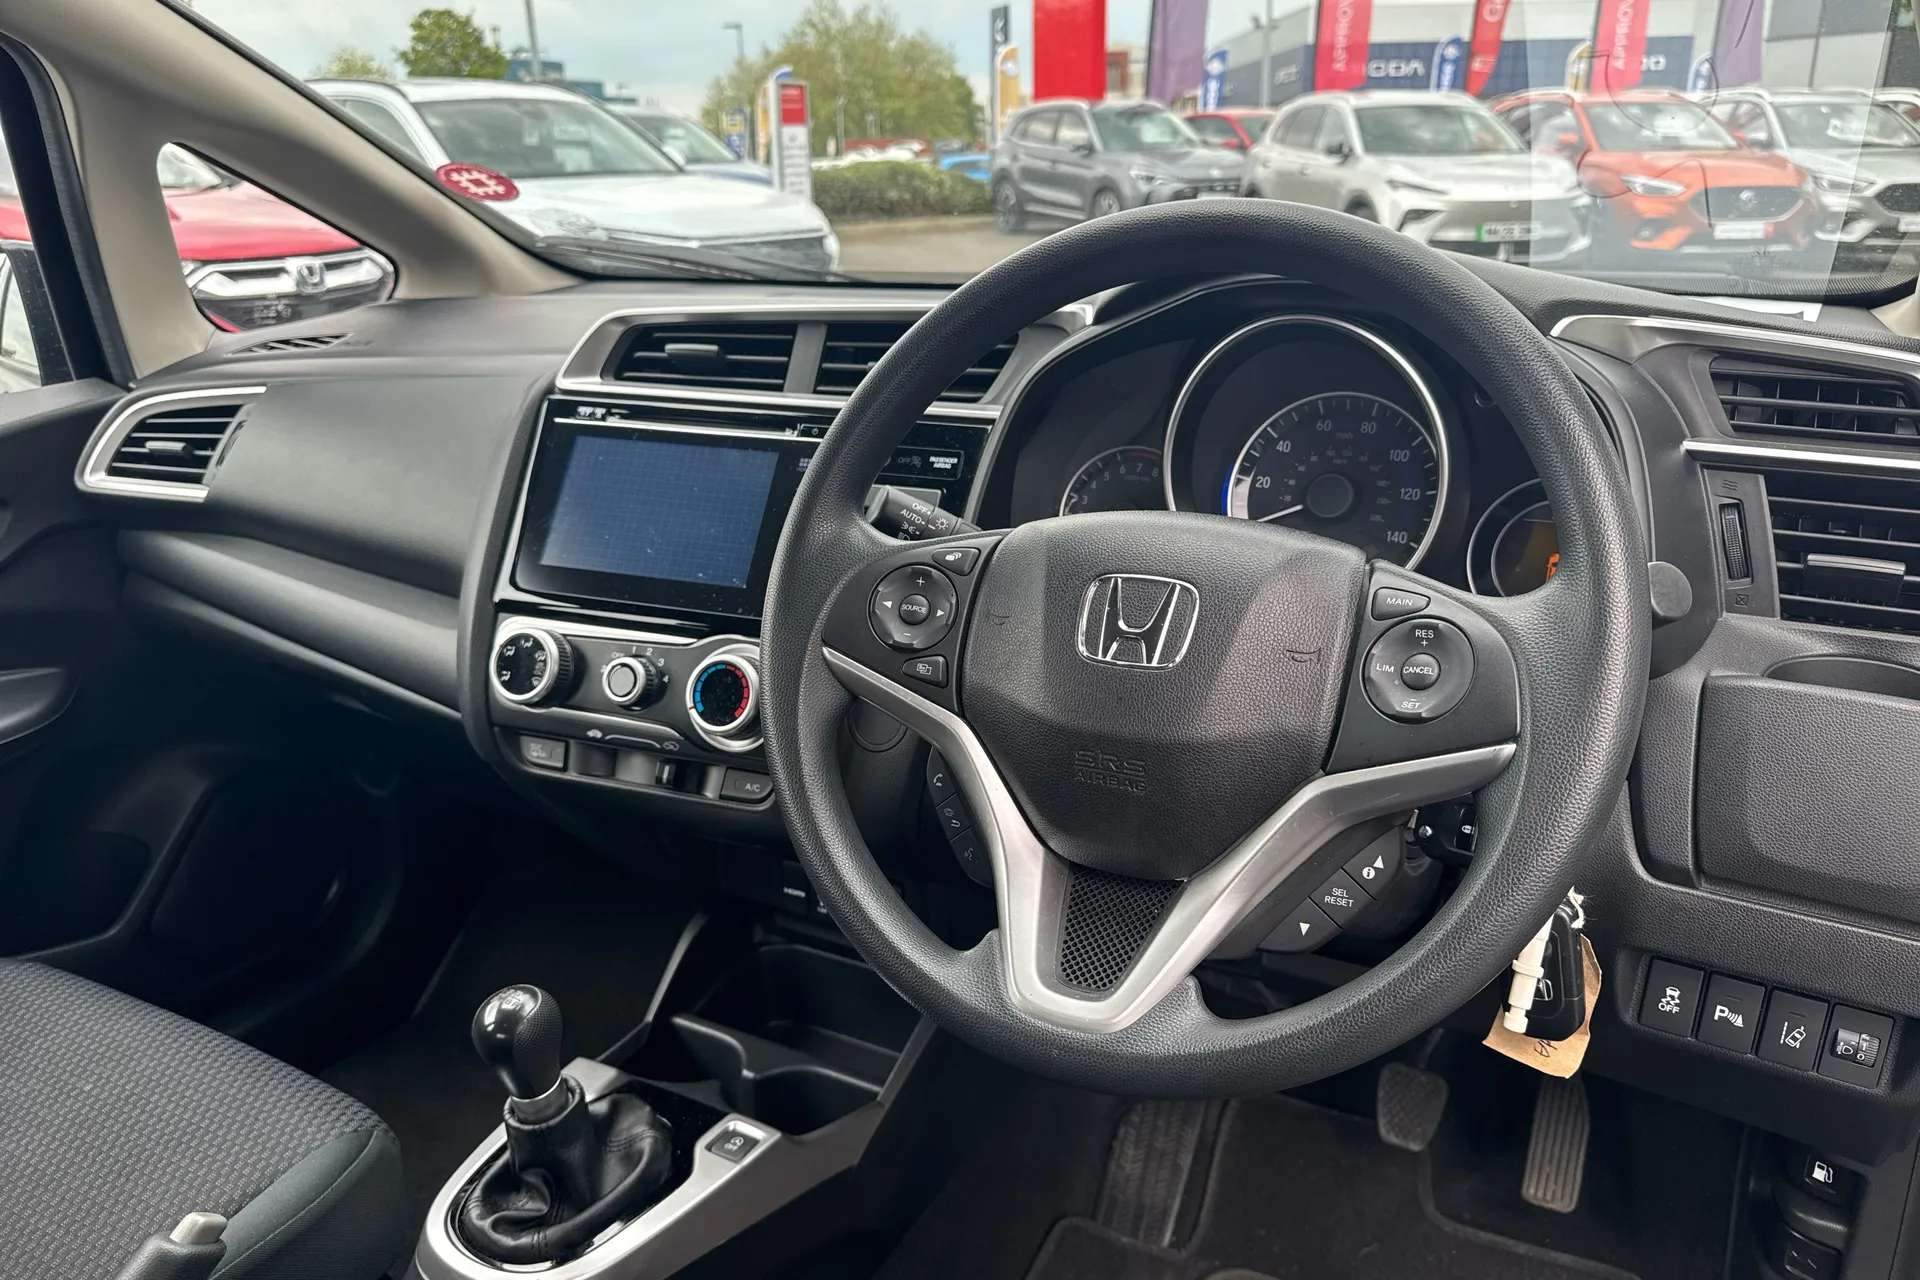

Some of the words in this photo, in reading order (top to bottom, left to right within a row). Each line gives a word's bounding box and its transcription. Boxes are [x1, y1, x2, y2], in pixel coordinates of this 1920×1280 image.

[1316, 420, 1332, 432] 60
[1360, 422, 1376, 434] 80
[1276, 440, 1292, 453] 40
[1389, 449, 1410, 462] 100
[1136, 463, 1143, 473] 7
[1255, 476, 1271, 489] 20
[1400, 488, 1421, 501] 120
[912, 502, 927, 514] OFF
[900, 509, 922, 524] AUTO
[1386, 531, 1408, 545] 140
[1386, 597, 1413, 606] MAIN
[901, 603, 927, 614] SOURCE
[1415, 629, 1434, 639] RES
[646, 647, 653, 656] 2
[657, 658, 665, 667] 3
[1376, 663, 1395, 673] LIM
[1403, 666, 1435, 675] CANCEL
[1400, 701, 1421, 709] SET
[1075, 751, 1146, 776] SRS
[745, 783, 760, 792] A/C
[1075, 771, 1146, 793] AIRBAG
[1332, 888, 1349, 897] SEL
[1324, 895, 1353, 906] RESET
[1658, 1002, 1681, 1014] OFF
